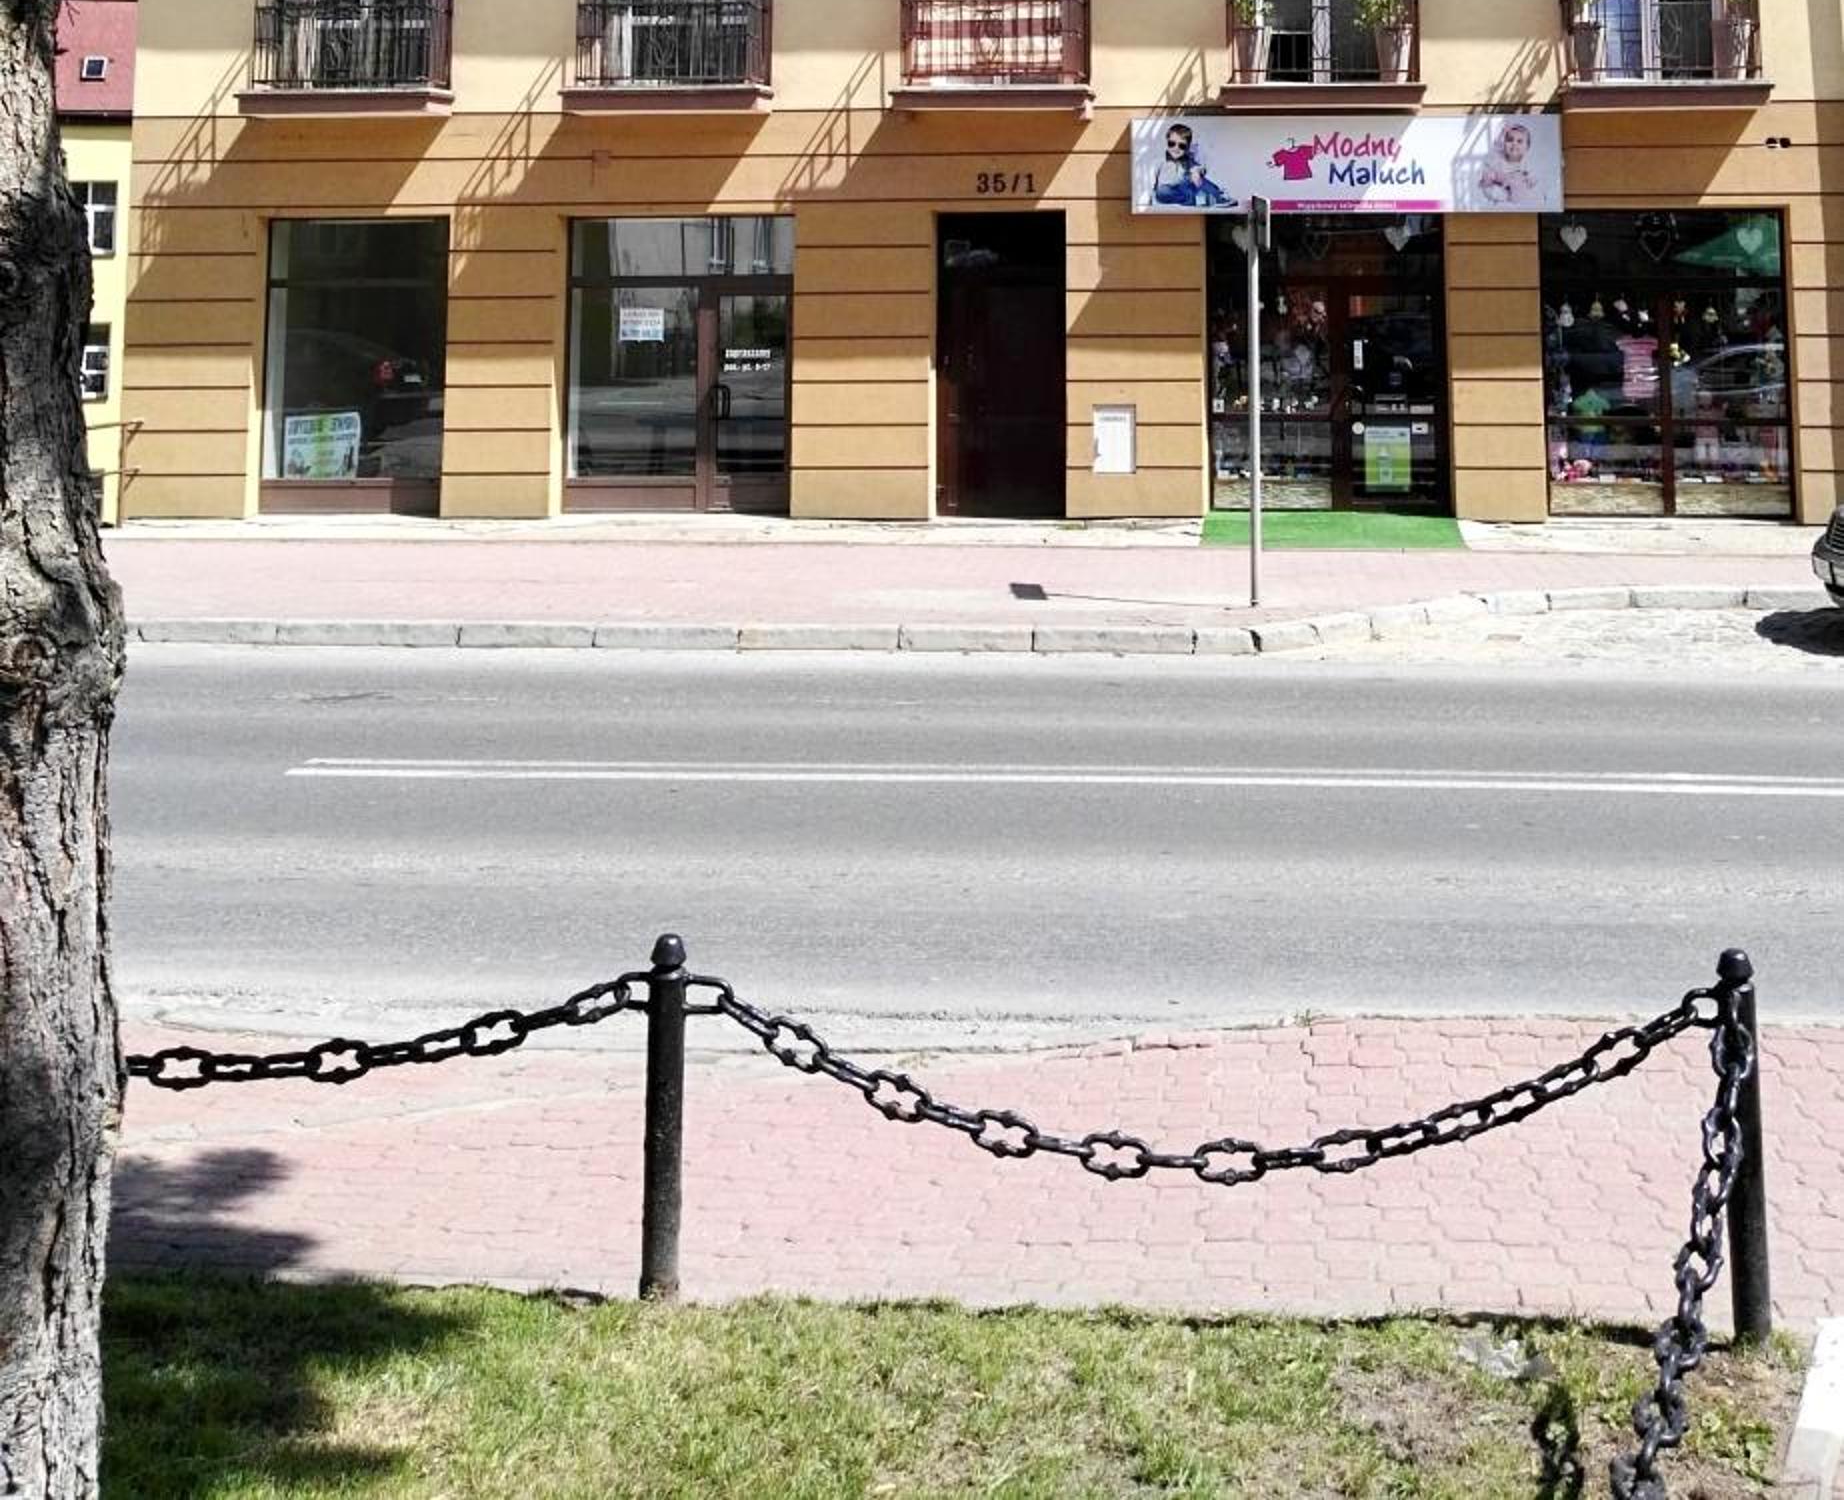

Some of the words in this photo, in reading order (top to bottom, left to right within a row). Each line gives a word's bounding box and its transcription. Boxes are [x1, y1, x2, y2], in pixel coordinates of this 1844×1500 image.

[1313, 131, 1402, 163] Modny
[976, 172, 1036, 193] 35/1
[1329, 158, 1425, 187] Maluch
